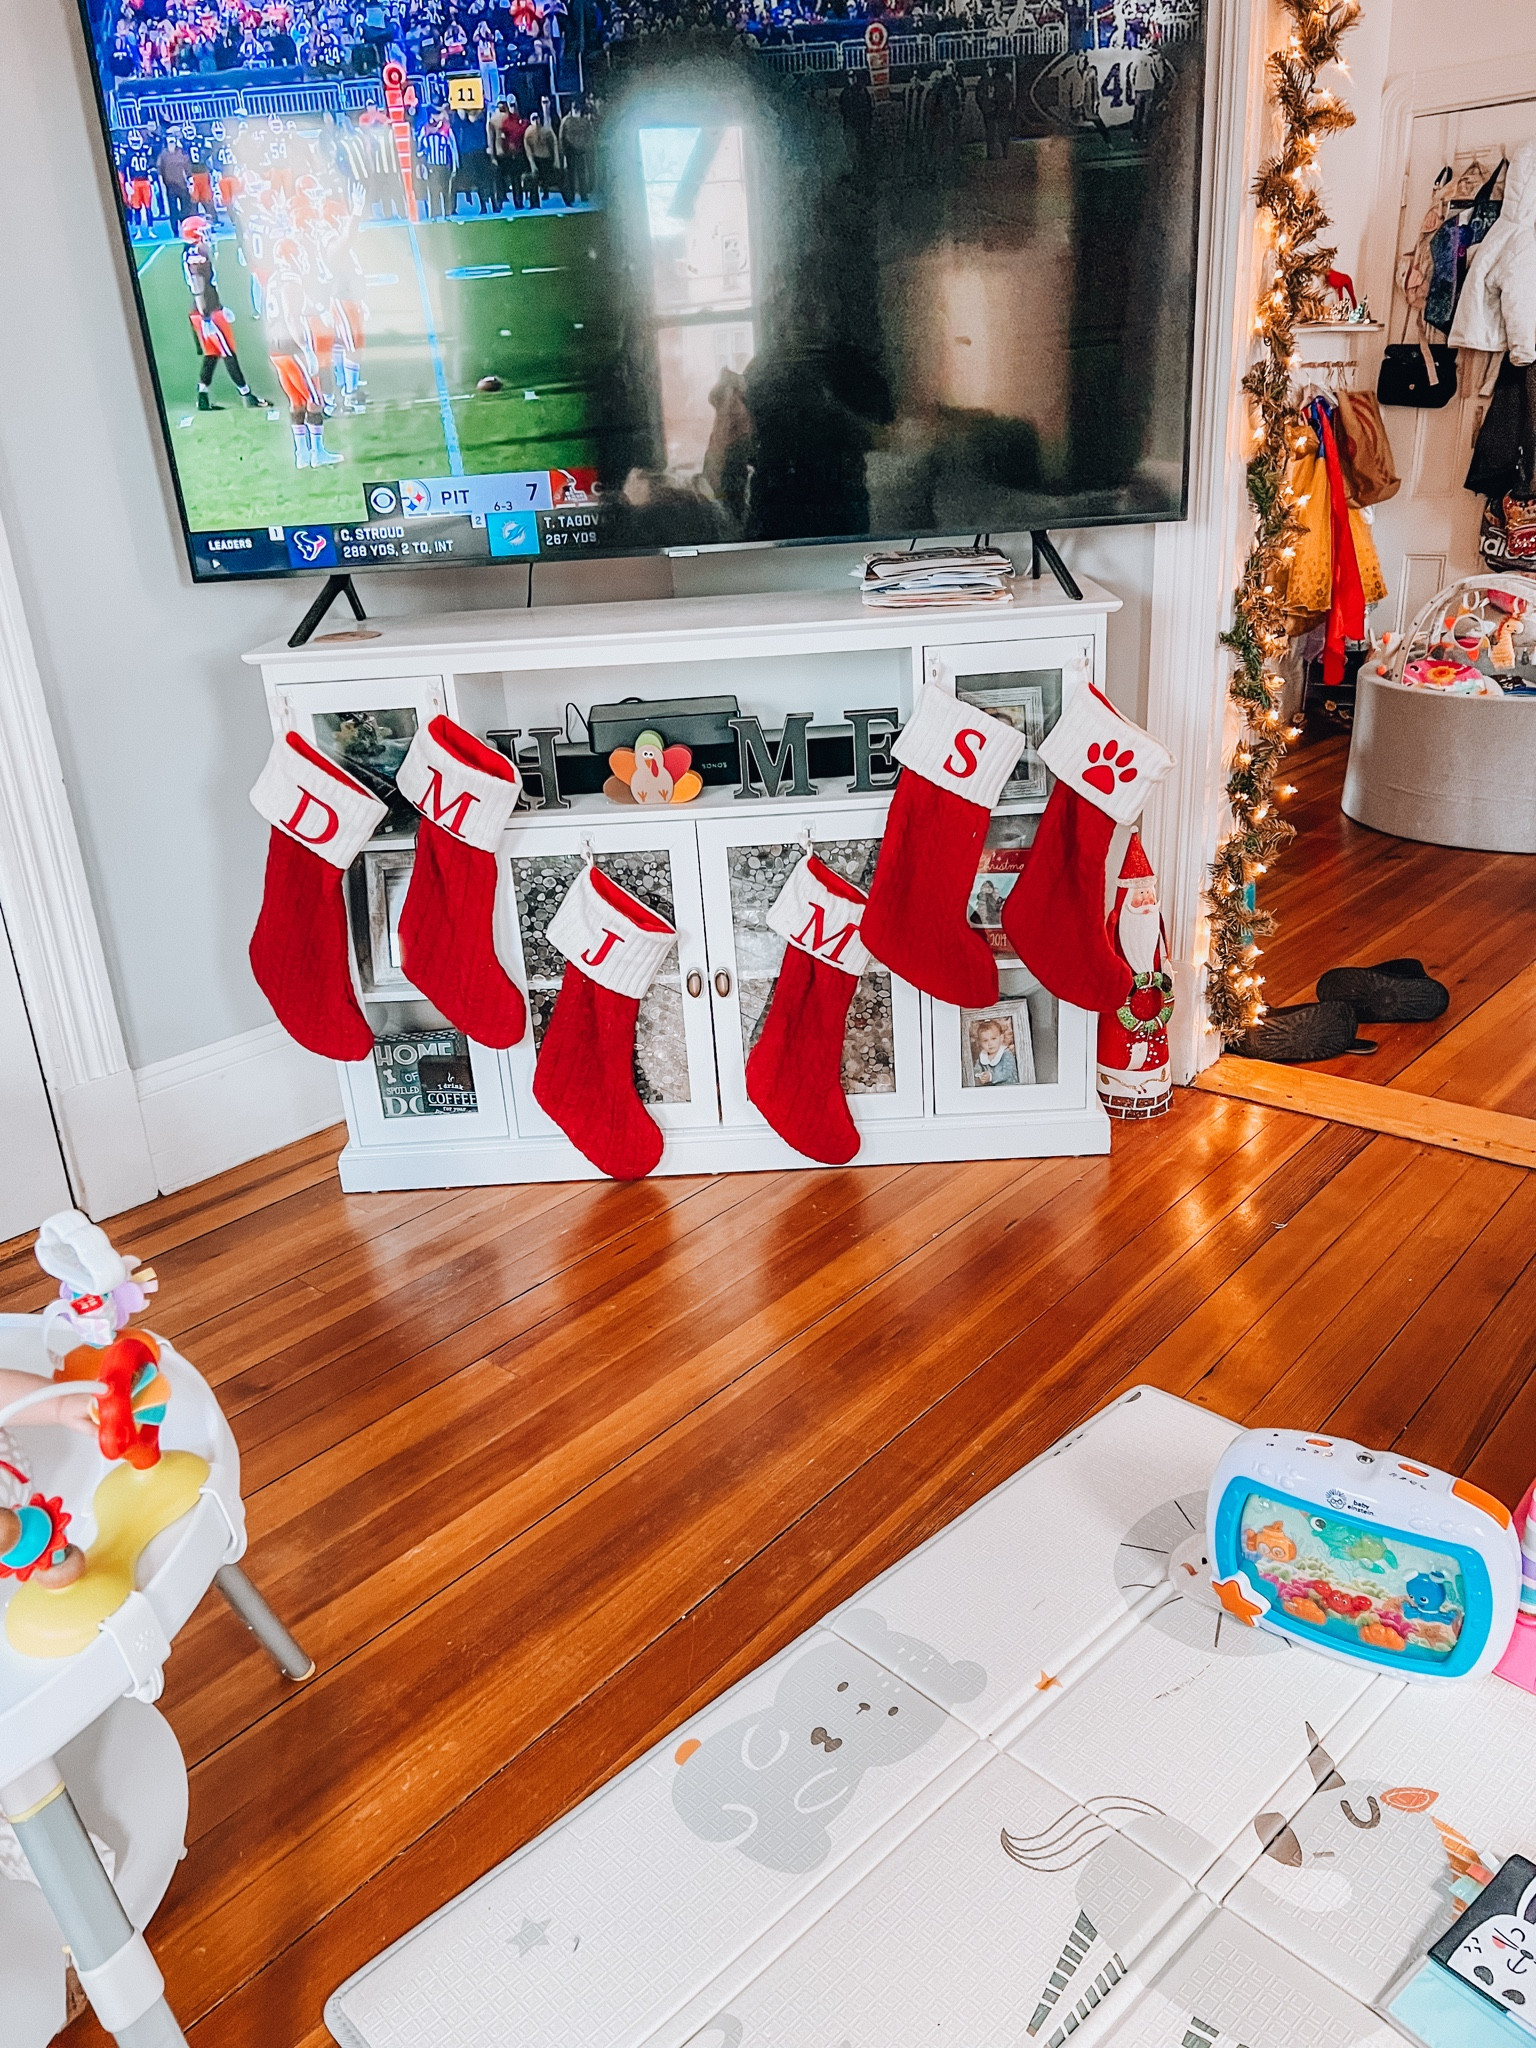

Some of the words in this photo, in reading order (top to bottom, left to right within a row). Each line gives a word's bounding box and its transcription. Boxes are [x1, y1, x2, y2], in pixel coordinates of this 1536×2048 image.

[457, 88, 475, 101] 11
[441, 490, 470, 505] PIT
[526, 484, 538, 501] 7
[493, 501, 513, 511] 6-3
[475, 516, 482, 525] 2
[543, 517, 555, 529] T.
[341, 529, 354, 541] C.
[355, 526, 405, 540] STROUD
[545, 533, 568, 546] 267
[208, 539, 252, 551] LEADERS
[343, 545, 367, 558] 288
[370, 543, 399, 556] YDS,
[401, 543, 410, 554] 2
[434, 540, 454, 553] INT
[943, 728, 987, 778] S
[701, 762, 727, 770] SONOS
[415, 766, 481, 838] M
[280, 785, 340, 844] D
[790, 902, 861, 965] M
[580, 928, 626, 967] J
[374, 1042, 452, 1067] HOME
[405, 1072, 419, 1083] OF
[386, 1085, 420, 1095] SPOILED
[443, 1082, 464, 1091] drink
[427, 1092, 477, 1105] COFFEE
[1347, 1504, 1375, 1515] einstein
[1353, 1499, 1369, 1509] baby
